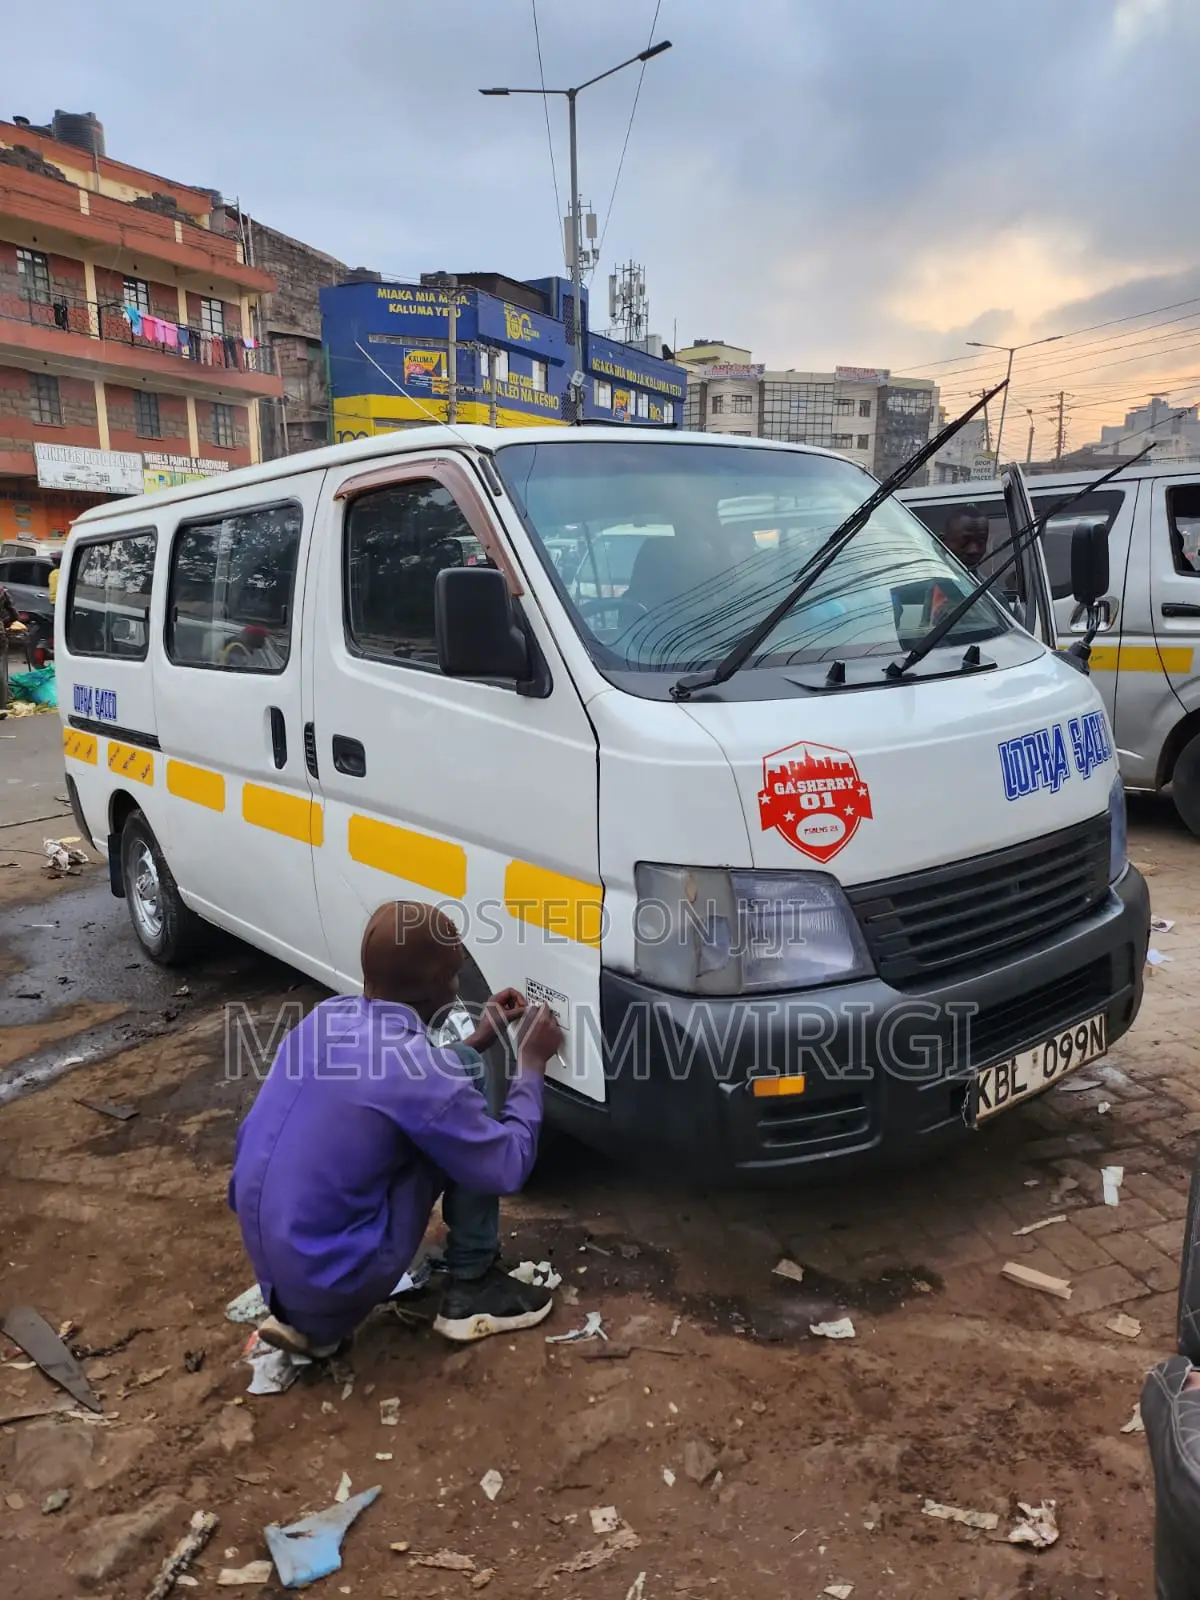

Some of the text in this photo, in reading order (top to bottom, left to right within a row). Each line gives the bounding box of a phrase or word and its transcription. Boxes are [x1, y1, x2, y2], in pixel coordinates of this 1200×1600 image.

[377, 287, 413, 301] MIAKA
[416, 291, 436, 302] MIA
[388, 304, 462, 318] KALUMA YEU
[520, 388, 533, 403] NA
[534, 391, 560, 410] KESHO
[197, 458, 230, 472] HARDWARE
[998, 723, 1070, 801] LOPHA
[799, 792, 836, 810] 01
[976, 1015, 1104, 1114] KBL 099N
